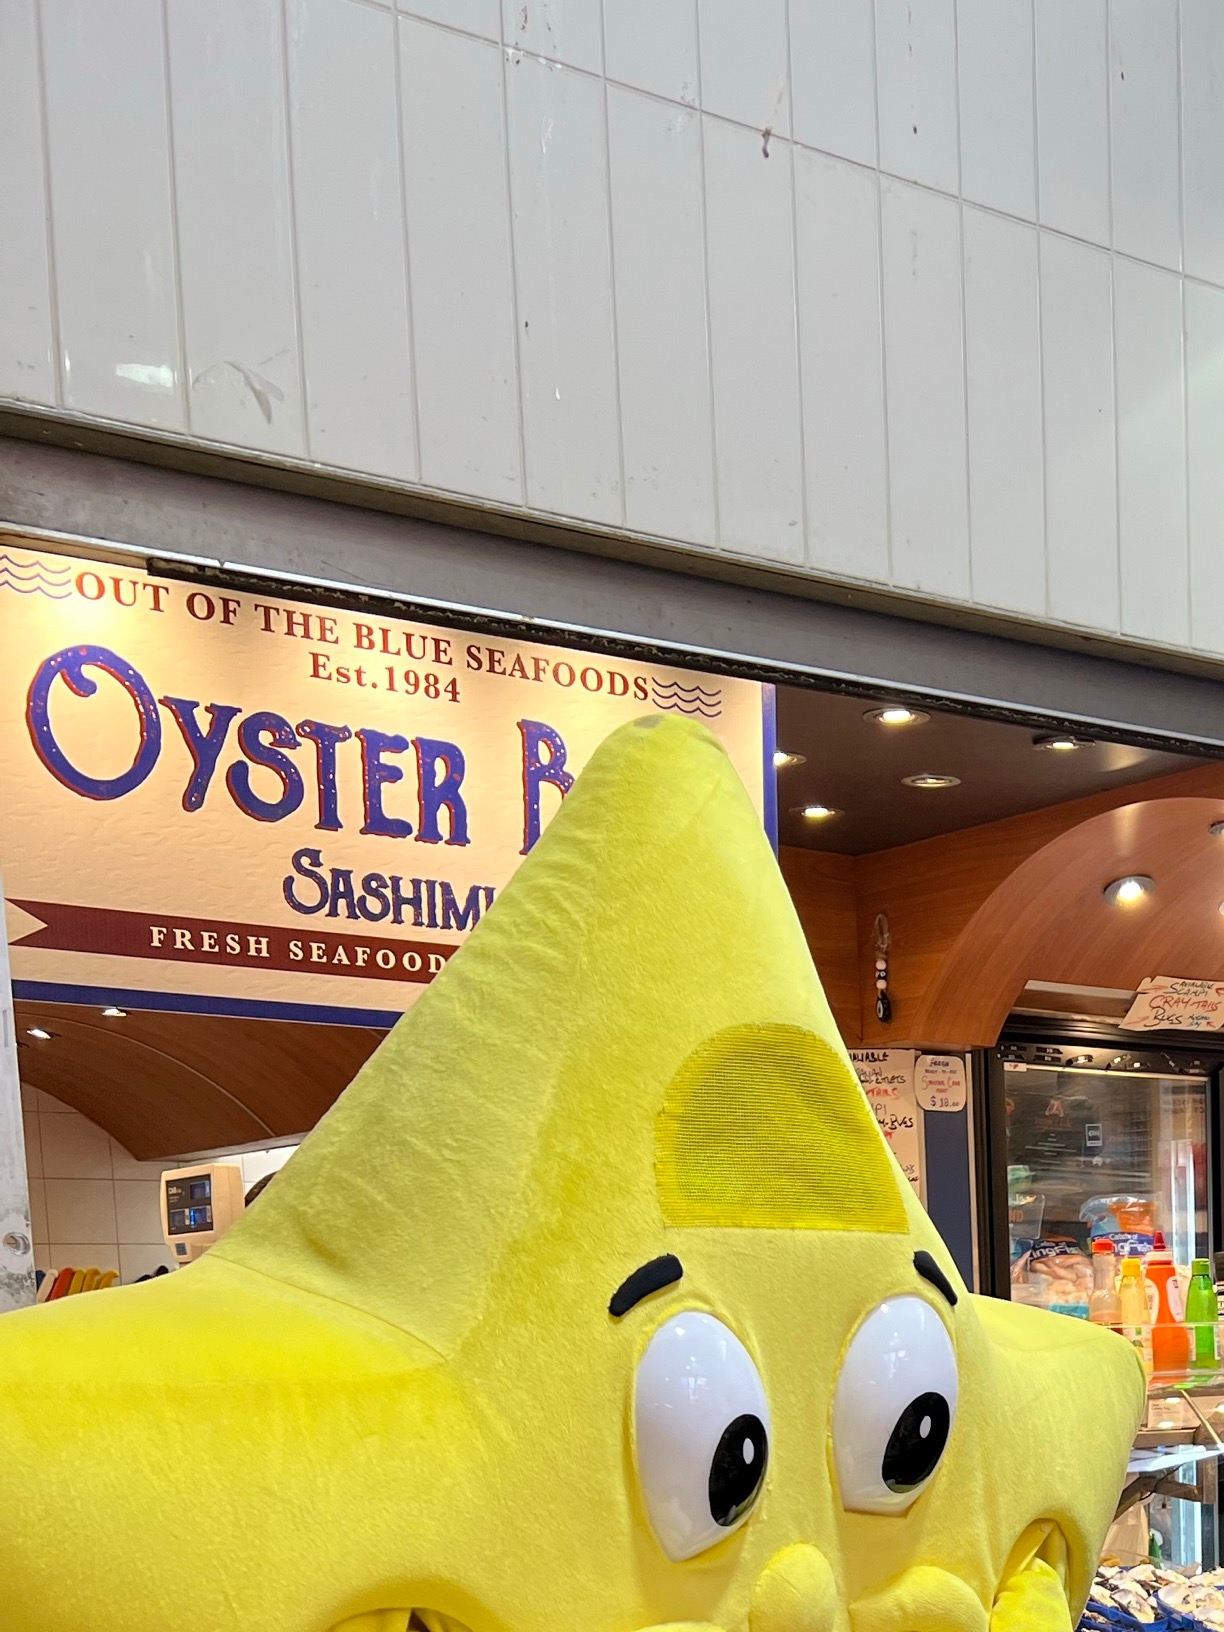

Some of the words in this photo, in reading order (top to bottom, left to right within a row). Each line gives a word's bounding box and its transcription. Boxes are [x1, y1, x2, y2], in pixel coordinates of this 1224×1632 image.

[74, 571, 170, 615] OUT
[186, 592, 242, 628] OF
[253, 604, 341, 646] THE
[352, 622, 454, 668] BLUE
[466, 644, 651, 702] SEAFOODS
[309, 652, 462, 704] Est.1984
[26, 644, 471, 848] OYSTER
[150, 926, 270, 958] FRESH
